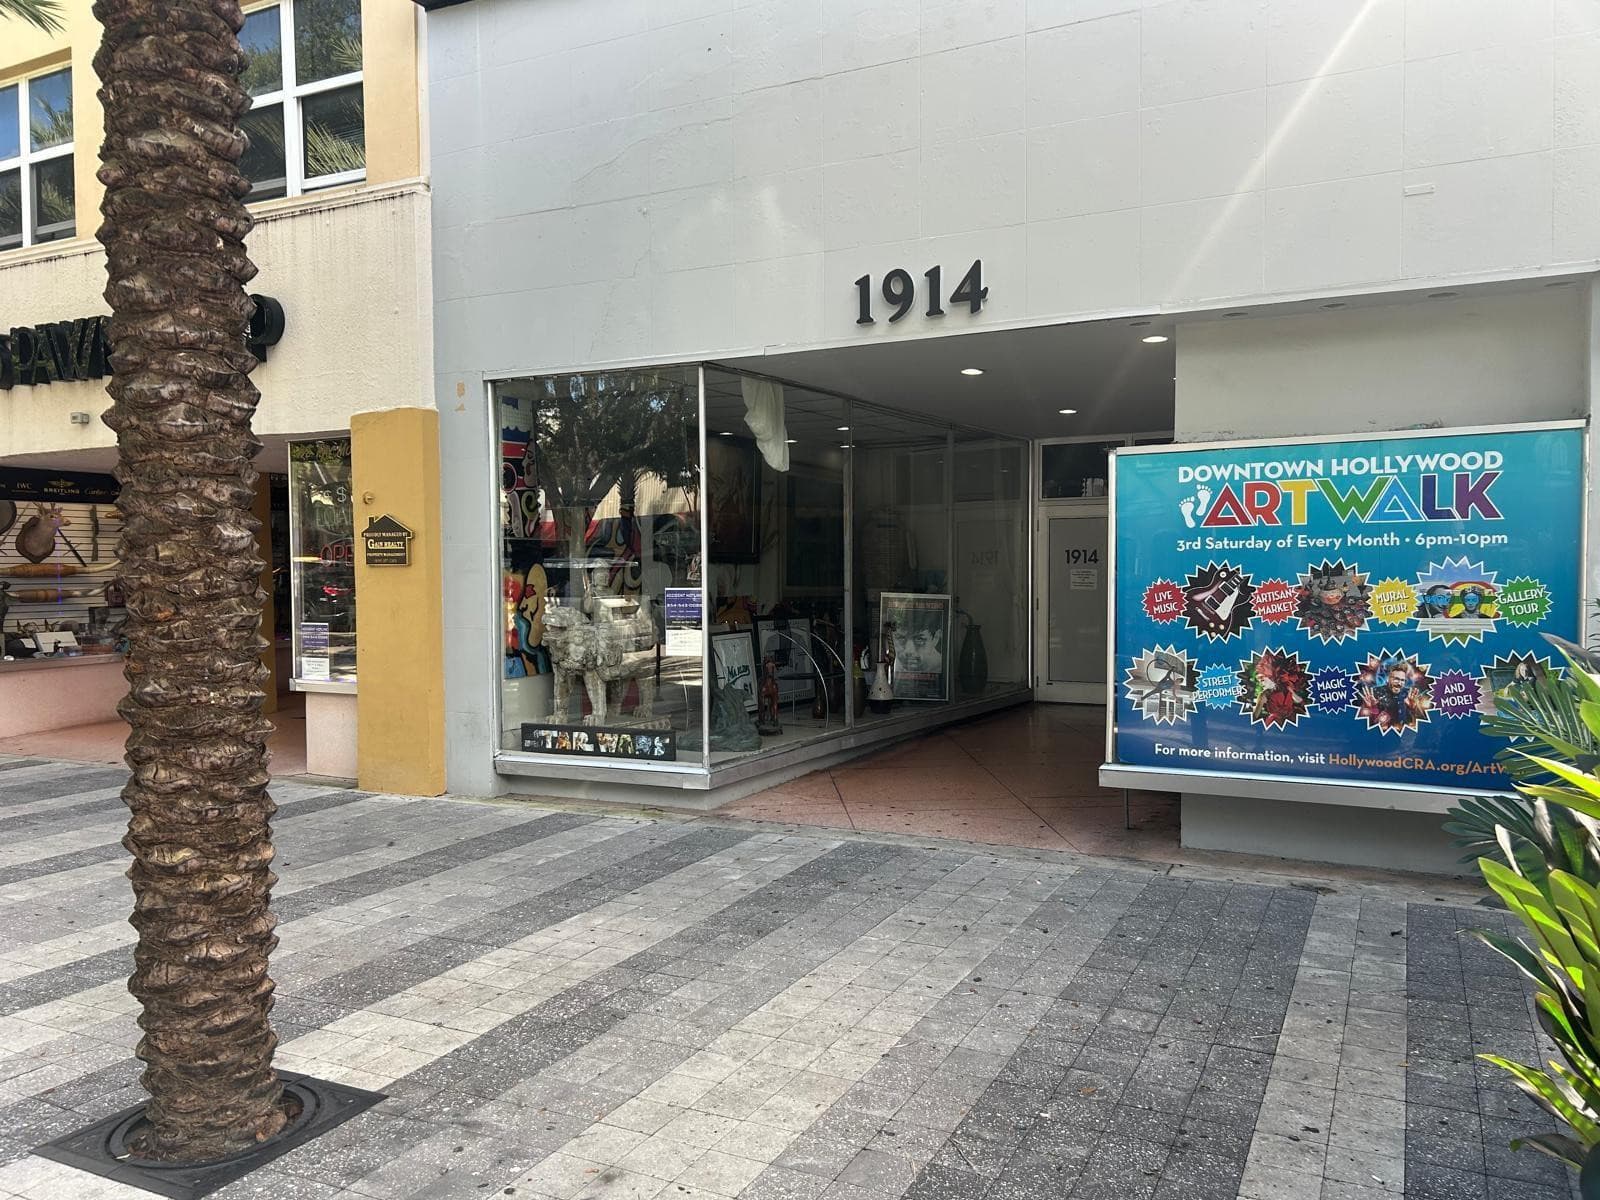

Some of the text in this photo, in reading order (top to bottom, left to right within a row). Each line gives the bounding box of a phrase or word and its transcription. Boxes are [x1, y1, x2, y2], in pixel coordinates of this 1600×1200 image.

[854, 259, 989, 324] 1914
[1178, 450, 1503, 483] DOWNTOWN HOLLYWOOD
[1176, 532, 1508, 551] 3rd Saturday of Every Month 6pm-10pm
[320, 543, 354, 567] OPE
[1065, 549, 1099, 564] 1914
[1154, 590, 1173, 602] LIVE
[1256, 589, 1293, 604] ARTISAN
[1376, 591, 1409, 603] MURAL
[1499, 588, 1545, 604] GALLERY
[1153, 602, 1179, 614] MUSIC
[1257, 602, 1294, 615] MARKET
[1380, 603, 1408, 614] TOUR
[1508, 603, 1539, 616] TOUR
[1202, 675, 1233, 687] STREET
[1317, 678, 1347, 691] MAGIC
[1192, 684, 1248, 700] PERFORMERS
[1444, 682, 1466, 695] AND
[1319, 690, 1347, 703] SHOW
[1440, 694, 1474, 708] MORE!
[1154, 743, 1175, 755] For
[1178, 747, 1211, 758] more
[1214, 746, 1294, 764] information,
[1297, 752, 1326, 765] visit
